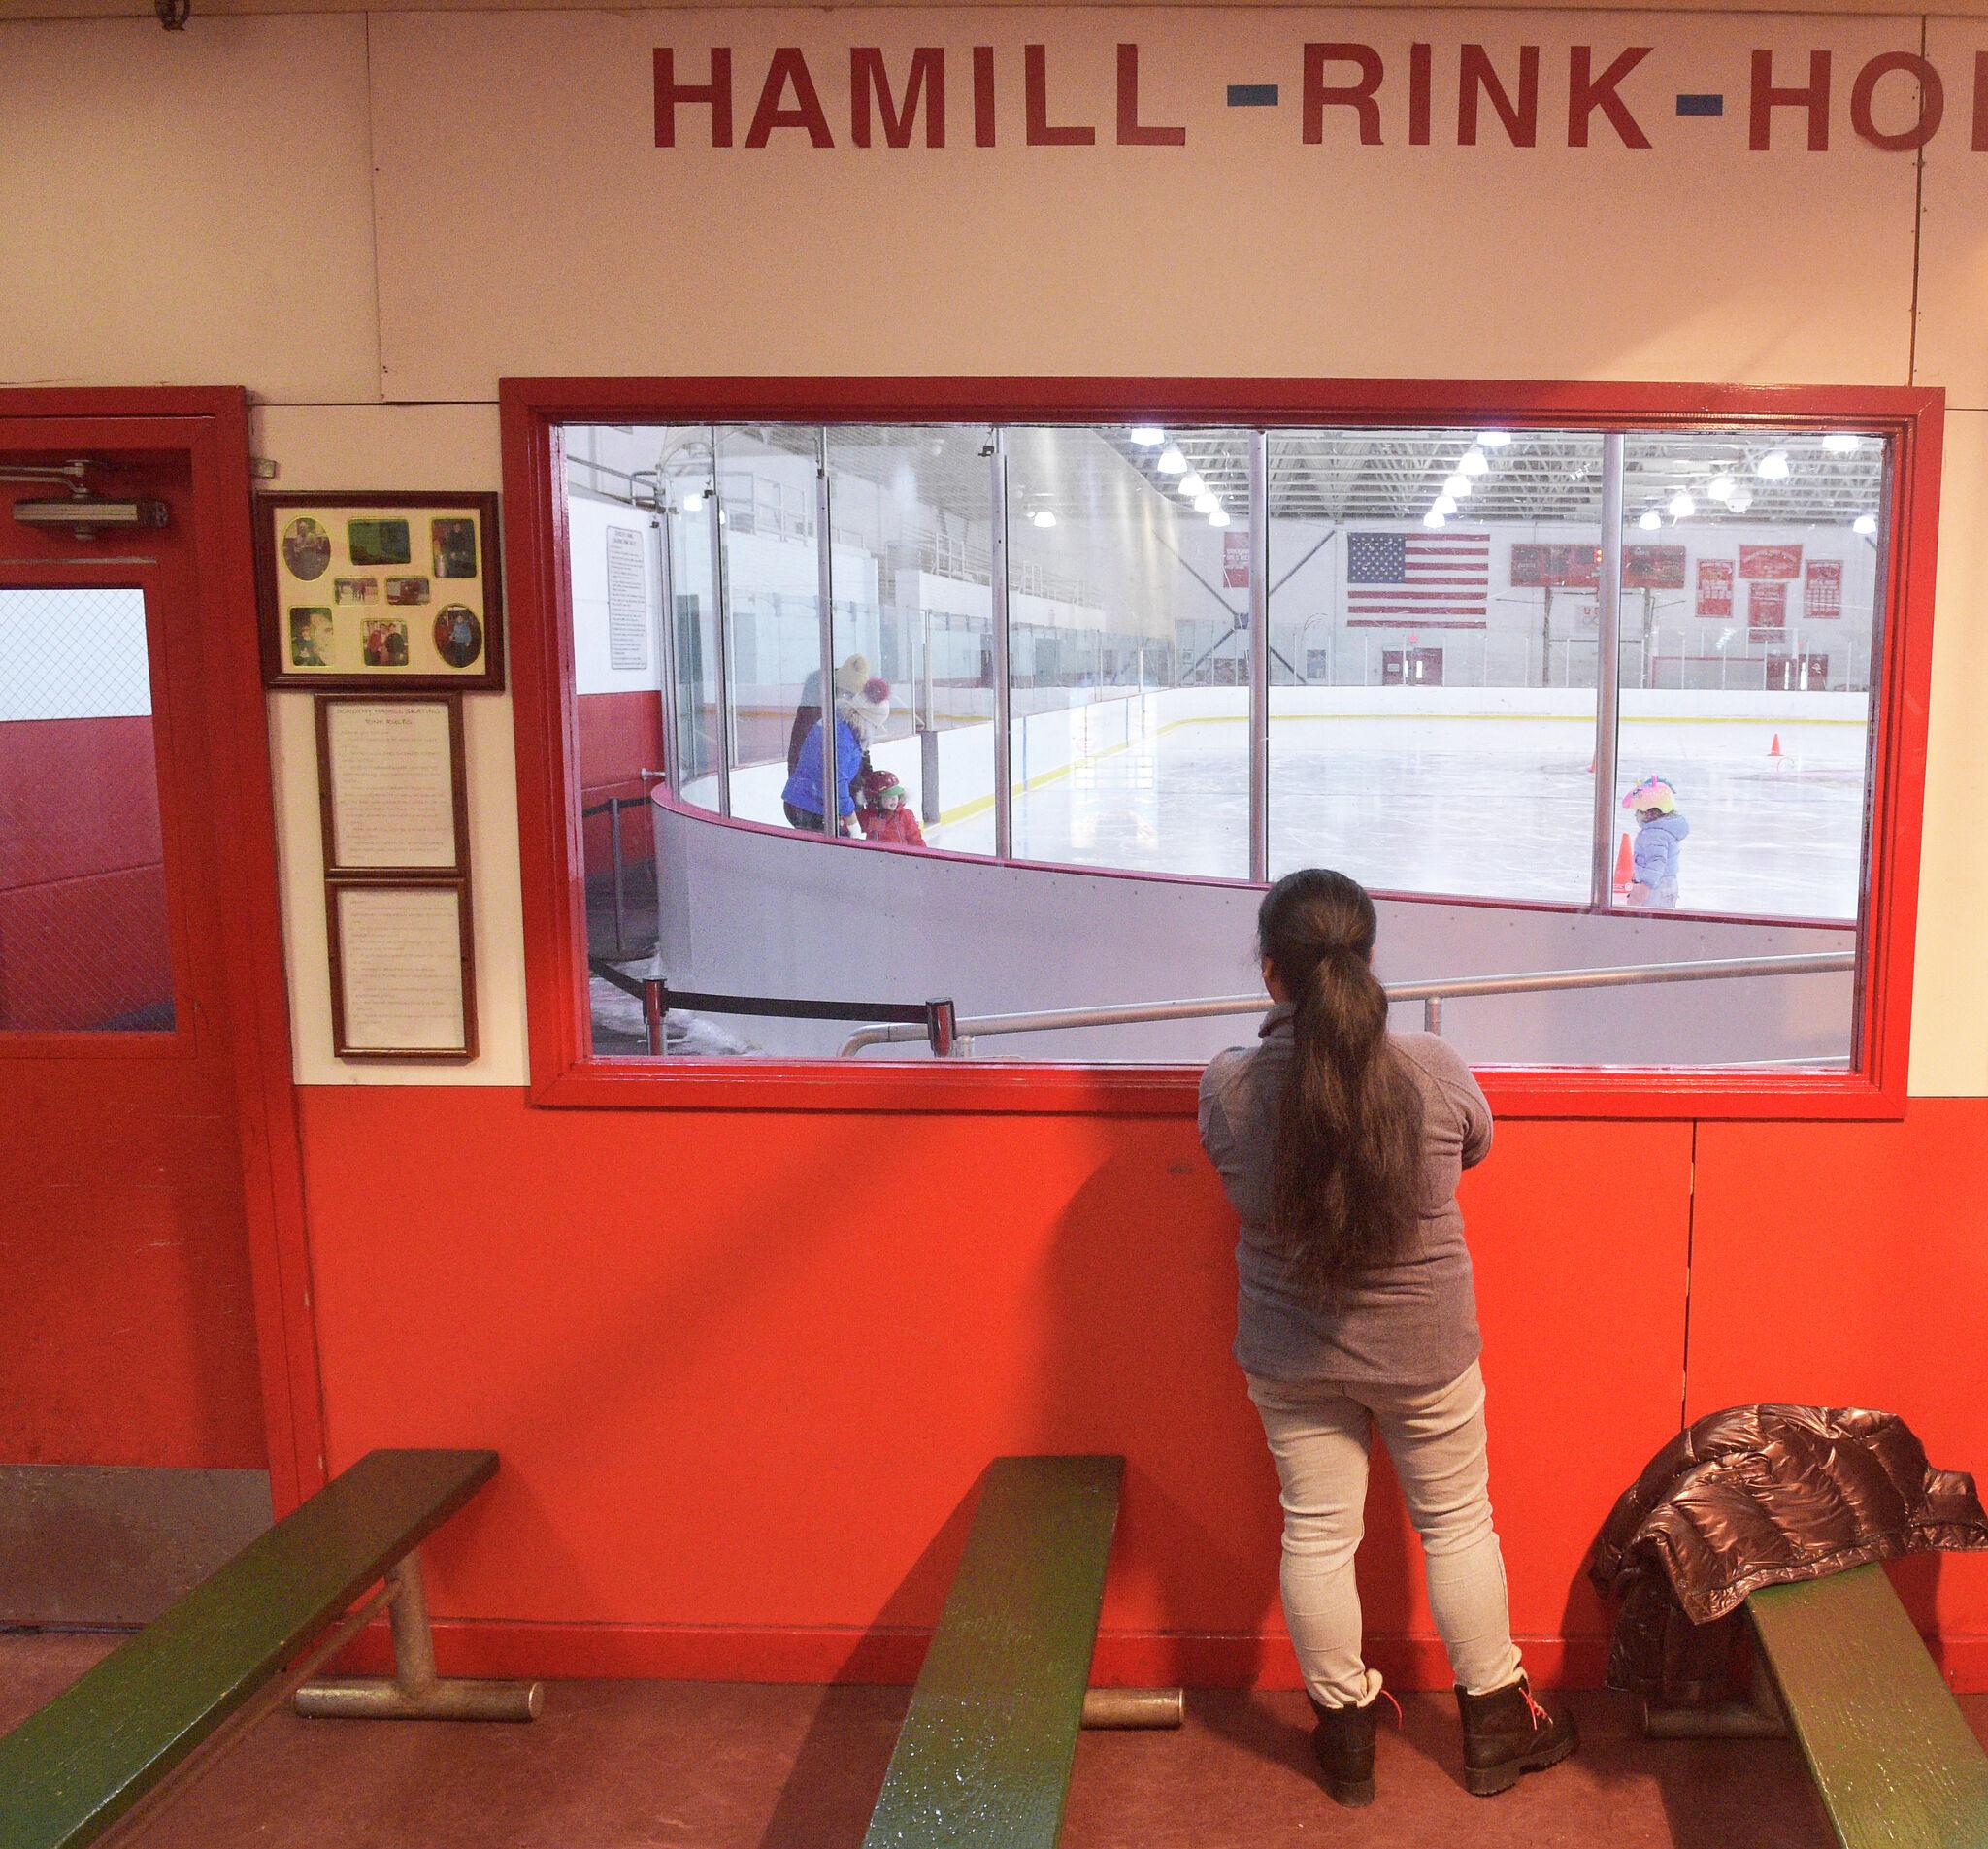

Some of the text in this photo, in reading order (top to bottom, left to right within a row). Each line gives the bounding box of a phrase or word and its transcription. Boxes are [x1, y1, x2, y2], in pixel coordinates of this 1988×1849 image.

[652, 43, 1186, 149] HAMILL
[1303, 42, 1654, 149] RINK
[1749, 49, 1988, 152] HO
